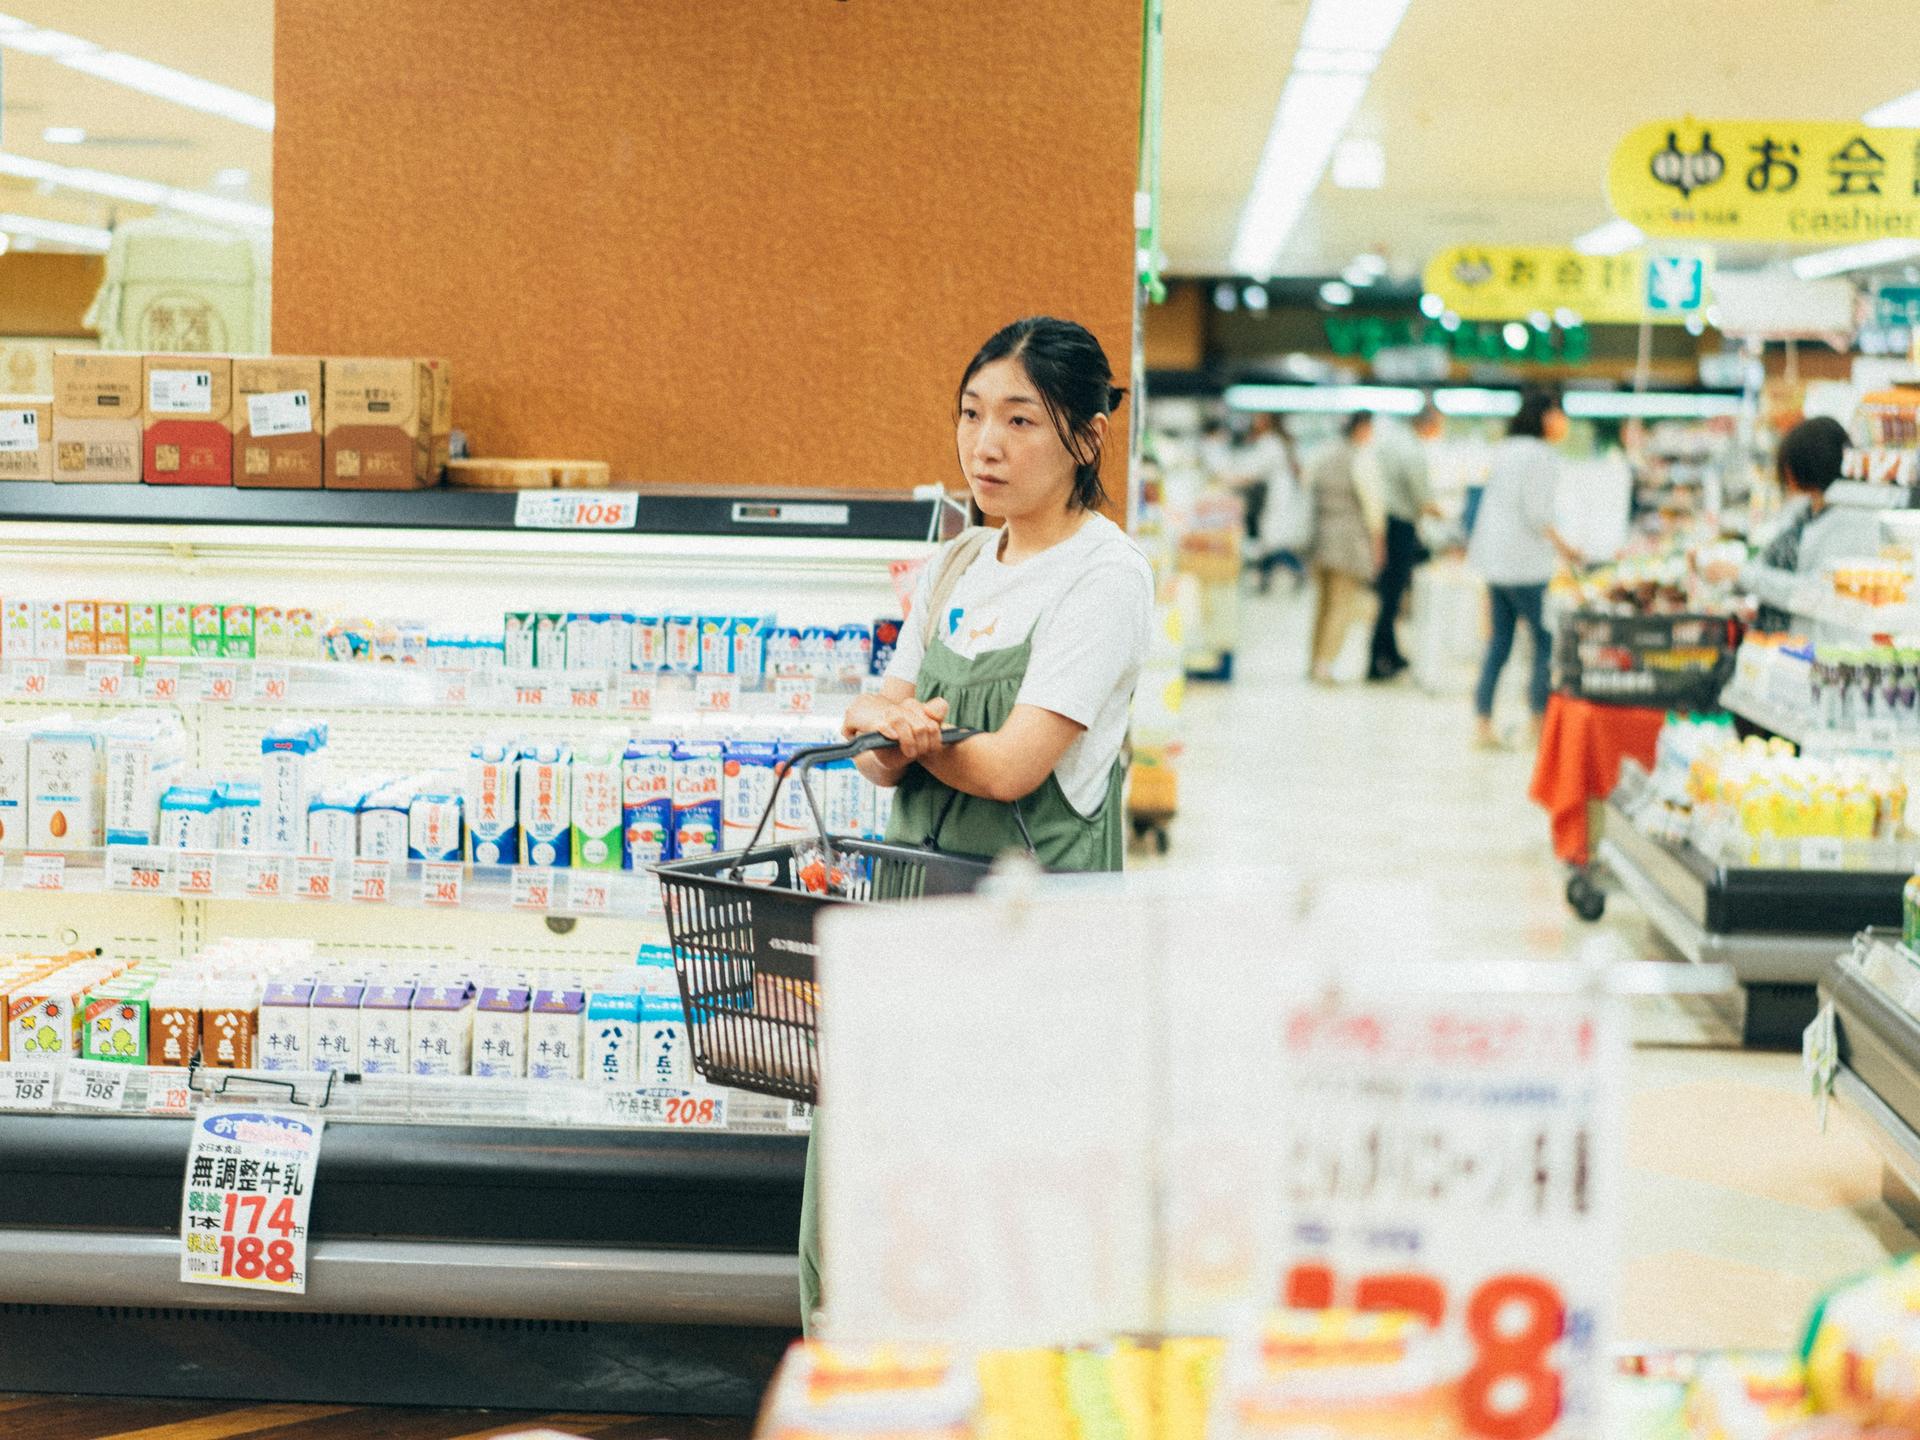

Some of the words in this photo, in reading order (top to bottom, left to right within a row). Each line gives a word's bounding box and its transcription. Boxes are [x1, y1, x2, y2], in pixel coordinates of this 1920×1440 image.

[576, 503, 622, 525] 108
[26, 675, 45, 692] 90
[99, 676, 119, 692] 90
[156, 678, 176, 694] 90
[213, 679, 232, 695] 90
[266, 680, 286, 695] 90
[131, 870, 160, 888] 298
[364, 879, 385, 896] 178
[267, 1034, 300, 1052] 牛乳
[317, 1035, 351, 1053] 牛乳
[369, 1036, 400, 1054] 牛乳
[418, 1037, 450, 1055] 牛乳
[481, 1039, 514, 1057] 牛乳
[536, 1040, 570, 1058] 牛乳
[15, 1085, 45, 1099] 198
[85, 1083, 115, 1100] 198
[165, 1089, 188, 1107] 128
[191, 1155, 304, 1196] 無調整牛乳
[188, 1215, 220, 1230] 1本
[222, 1193, 296, 1237] 174
[219, 1235, 295, 1283] 188
